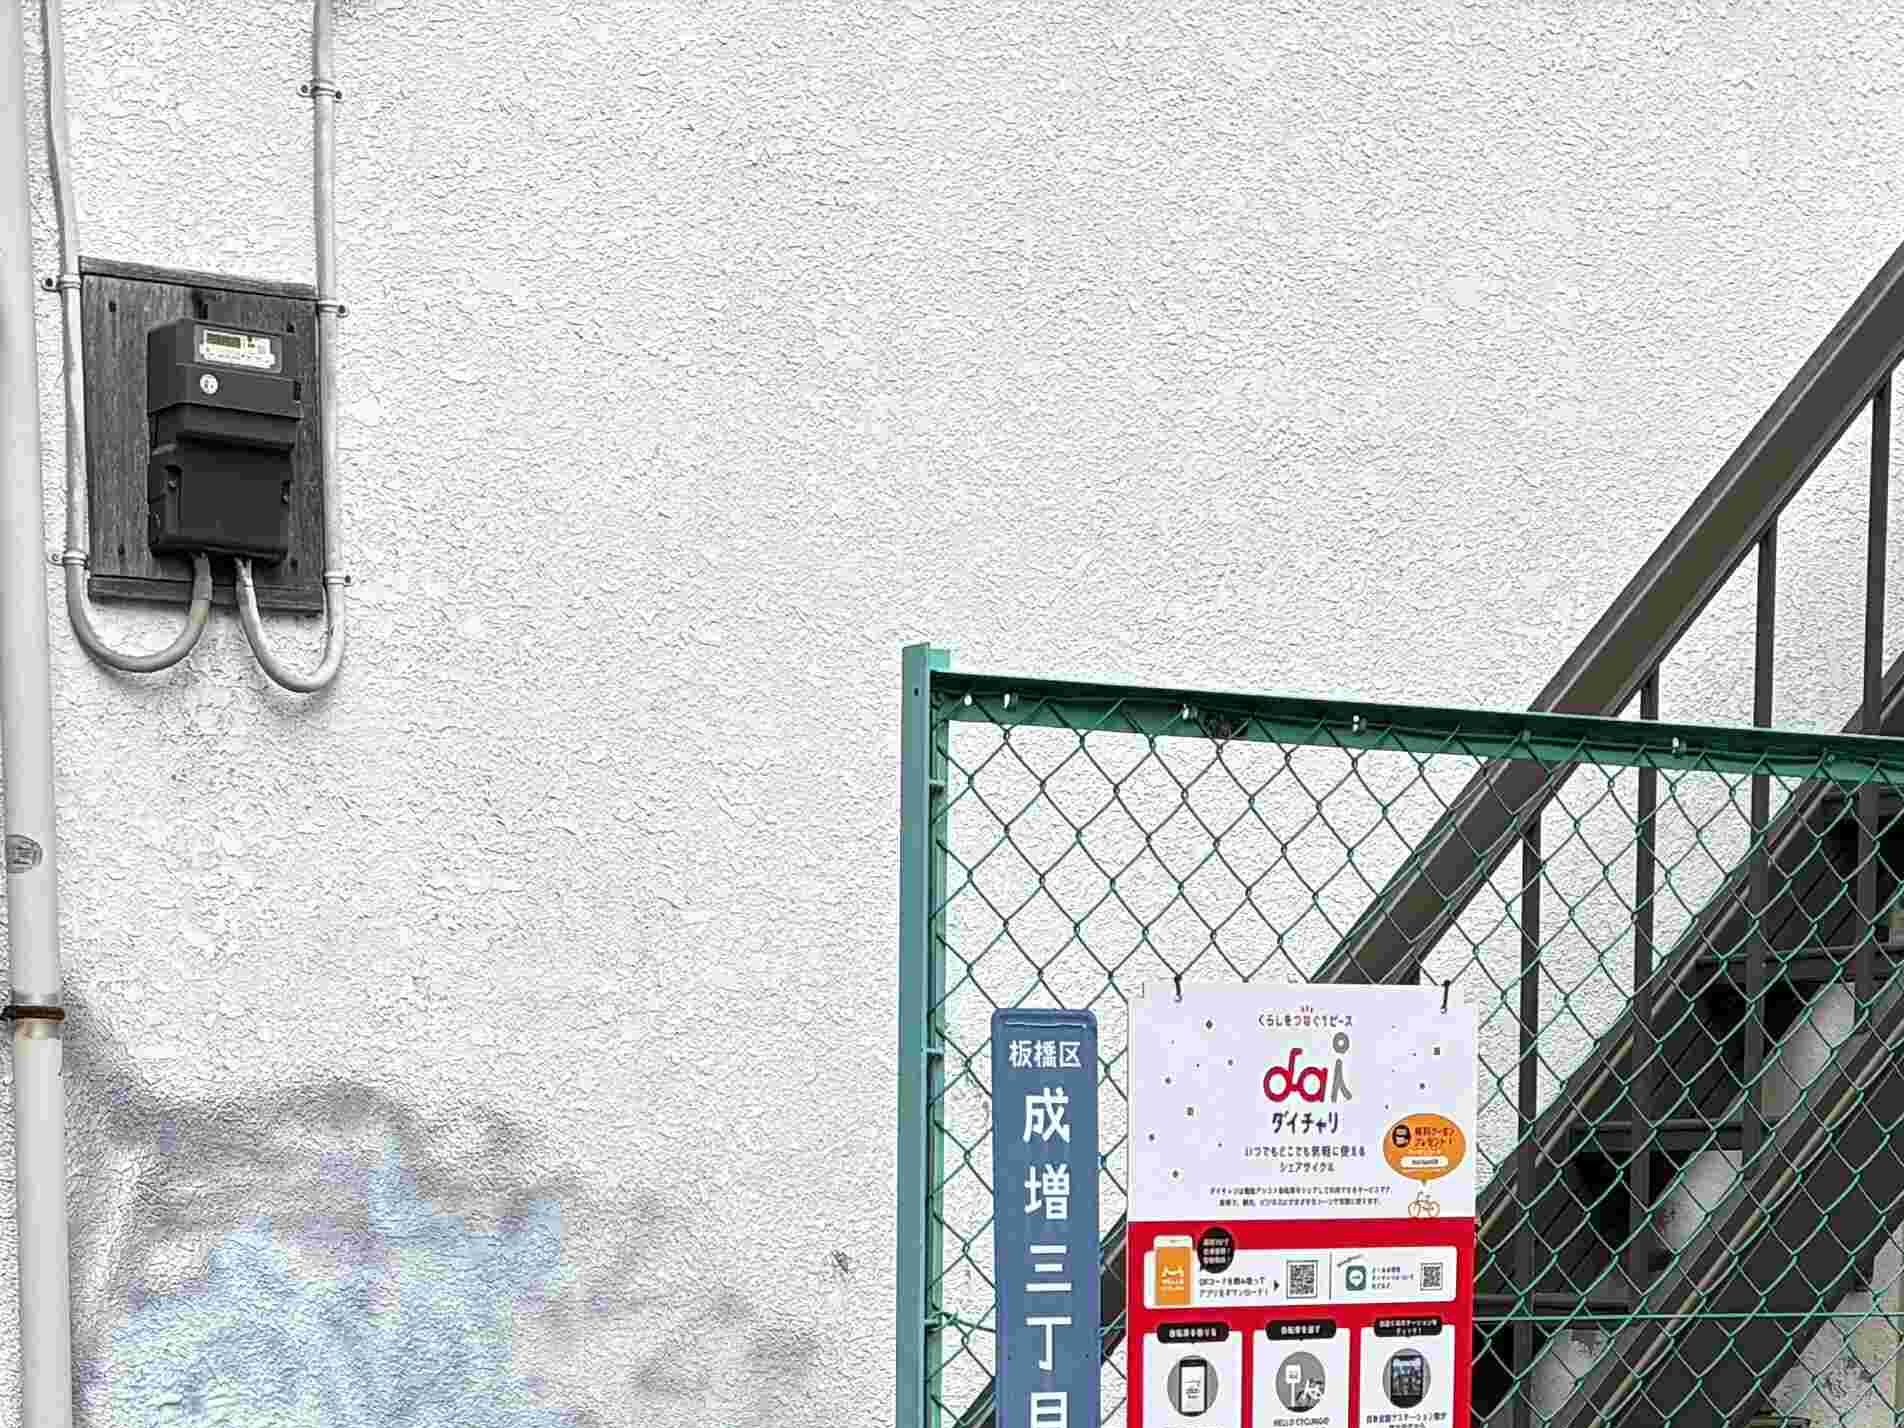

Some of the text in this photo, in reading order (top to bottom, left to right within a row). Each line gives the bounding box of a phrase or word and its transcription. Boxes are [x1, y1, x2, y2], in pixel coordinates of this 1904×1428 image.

[1008, 1040, 1082, 1069] 板橋区
[1271, 1111, 1340, 1135] ダイチャリ
